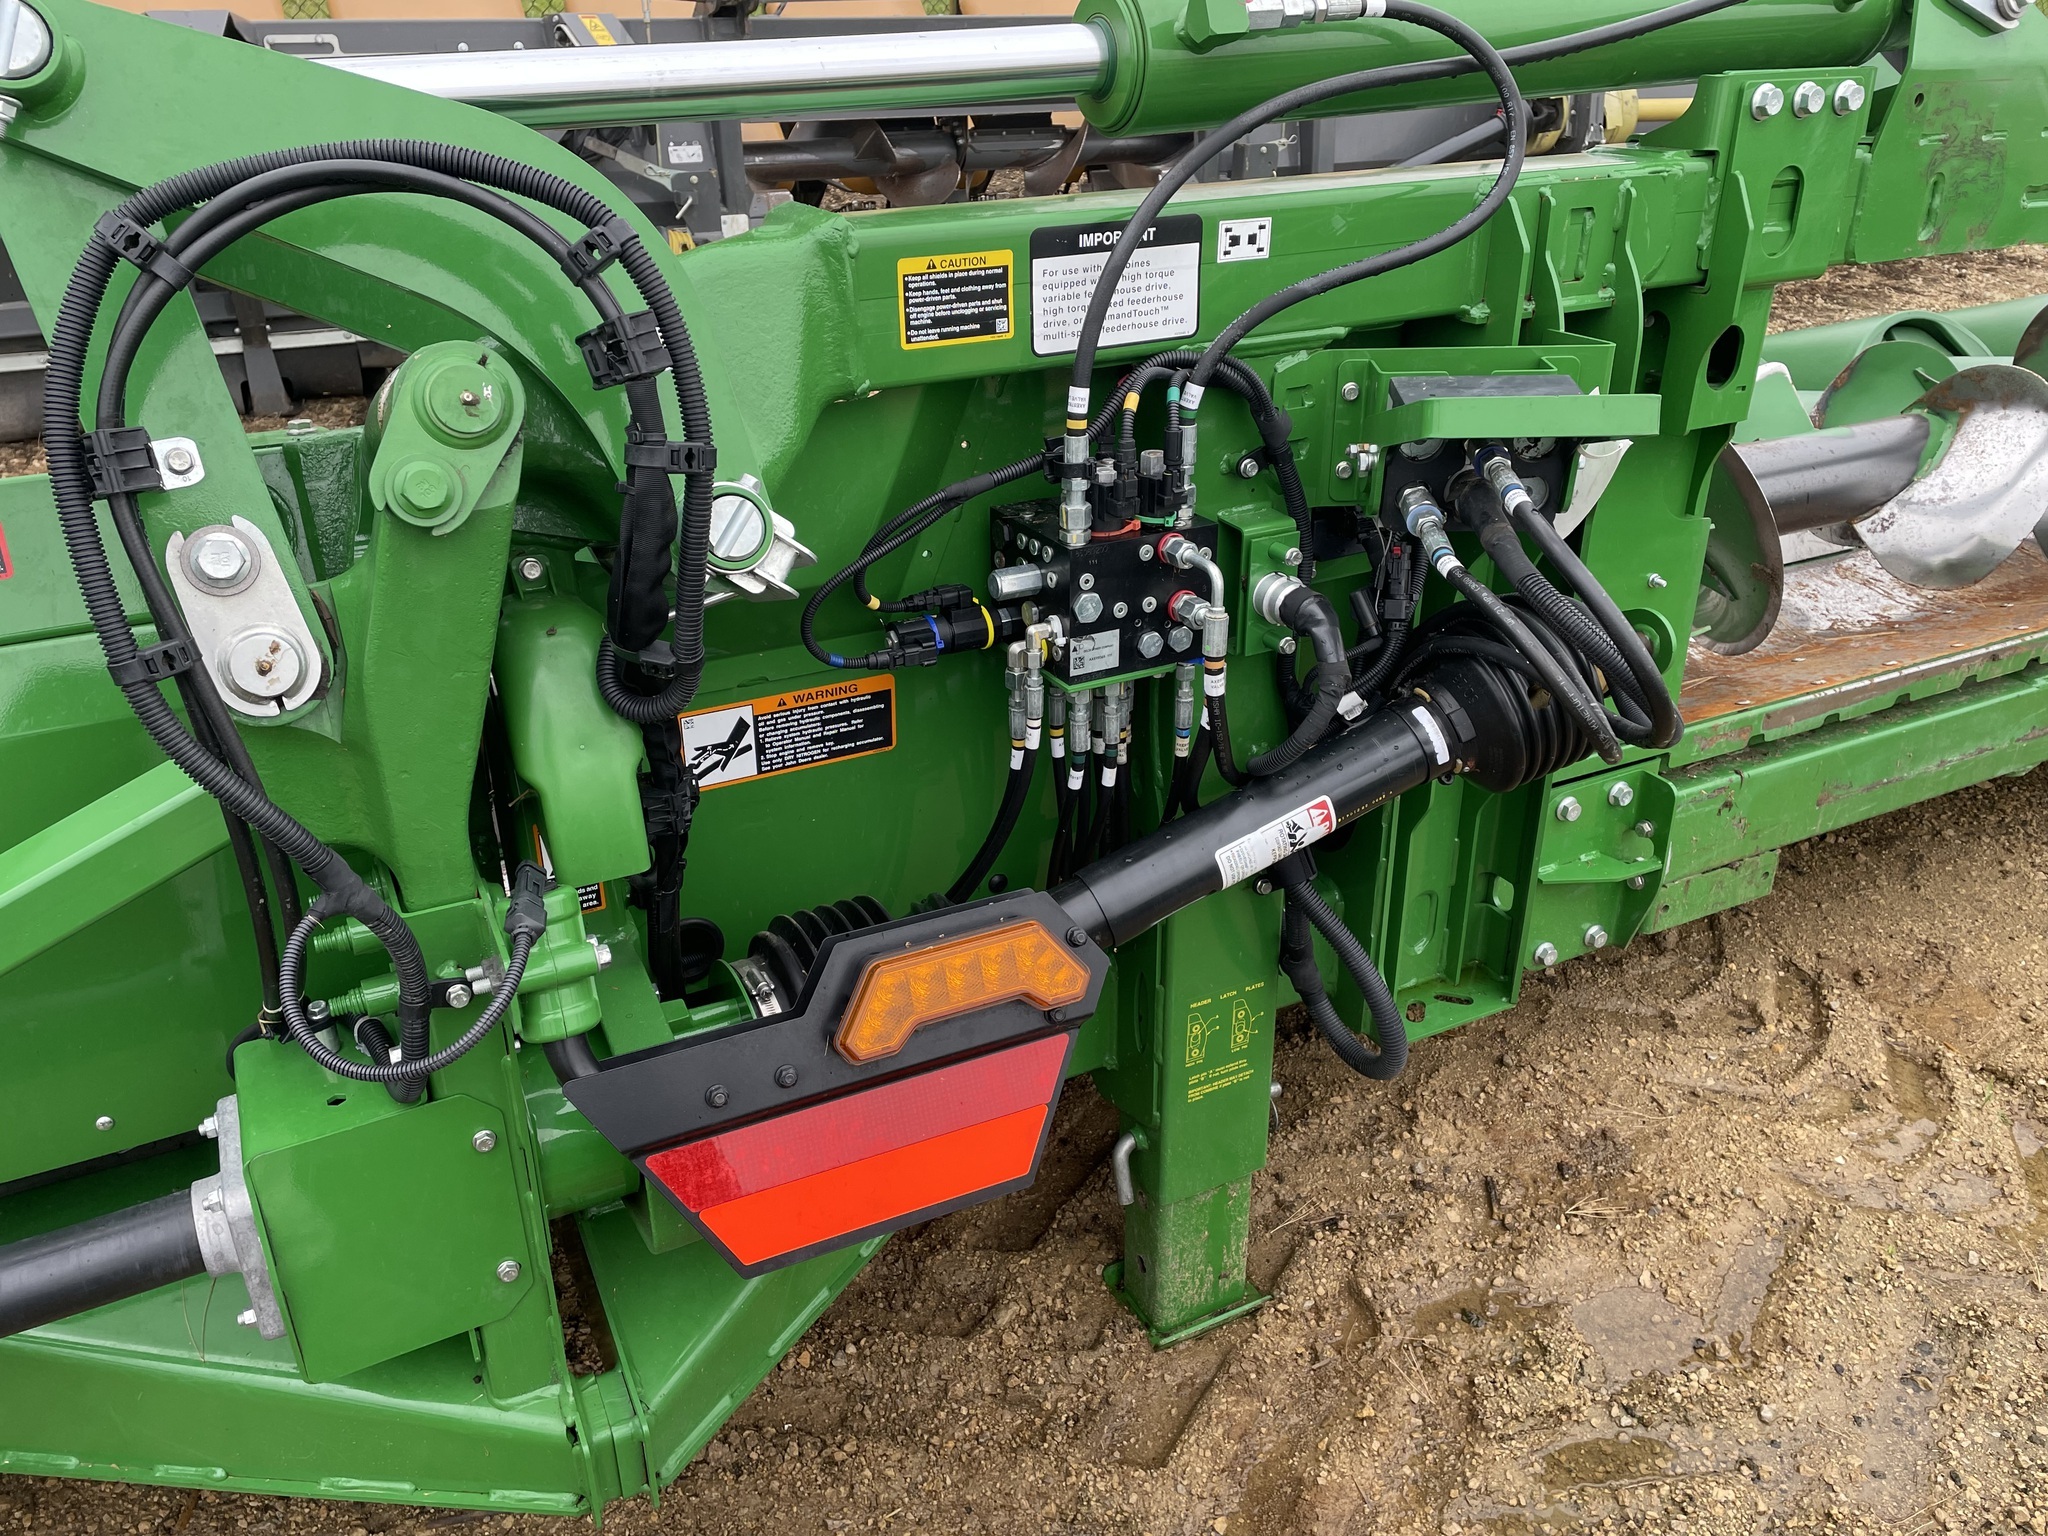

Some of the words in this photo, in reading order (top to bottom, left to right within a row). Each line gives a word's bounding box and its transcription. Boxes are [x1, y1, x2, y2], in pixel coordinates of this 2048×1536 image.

[940, 256, 987, 269] CAUTION
[954, 270, 968, 278] place
[1042, 269, 1060, 277] For
[1062, 265, 1079, 275] use
[1083, 265, 1102, 273] with
[1042, 278, 1086, 291] equipped
[1121, 270, 1142, 282] high
[1145, 269, 1175, 279] torque
[1042, 290, 1080, 303] variable
[1145, 282, 1171, 292] drive,
[909, 295, 941, 304] power-driven
[1043, 306, 1064, 317] high
[1127, 292, 1184, 306] feederhouse
[910, 305, 935, 313] Disengage
[936, 302, 968, 310] power-driven
[952, 306, 978, 315] unclogging
[1043, 318, 1070, 328] drive,
[1102, 320, 1158, 333] feederhouse
[1162, 316, 1187, 326] drive.
[793, 684, 858, 704] WARNING
[796, 749, 821, 758] NITROGEN
[586, 884, 598, 892] and
[1190, 998, 1211, 1008] HEADER
[1220, 991, 1237, 999] LATCH
[1245, 982, 1264, 991] PLATES
